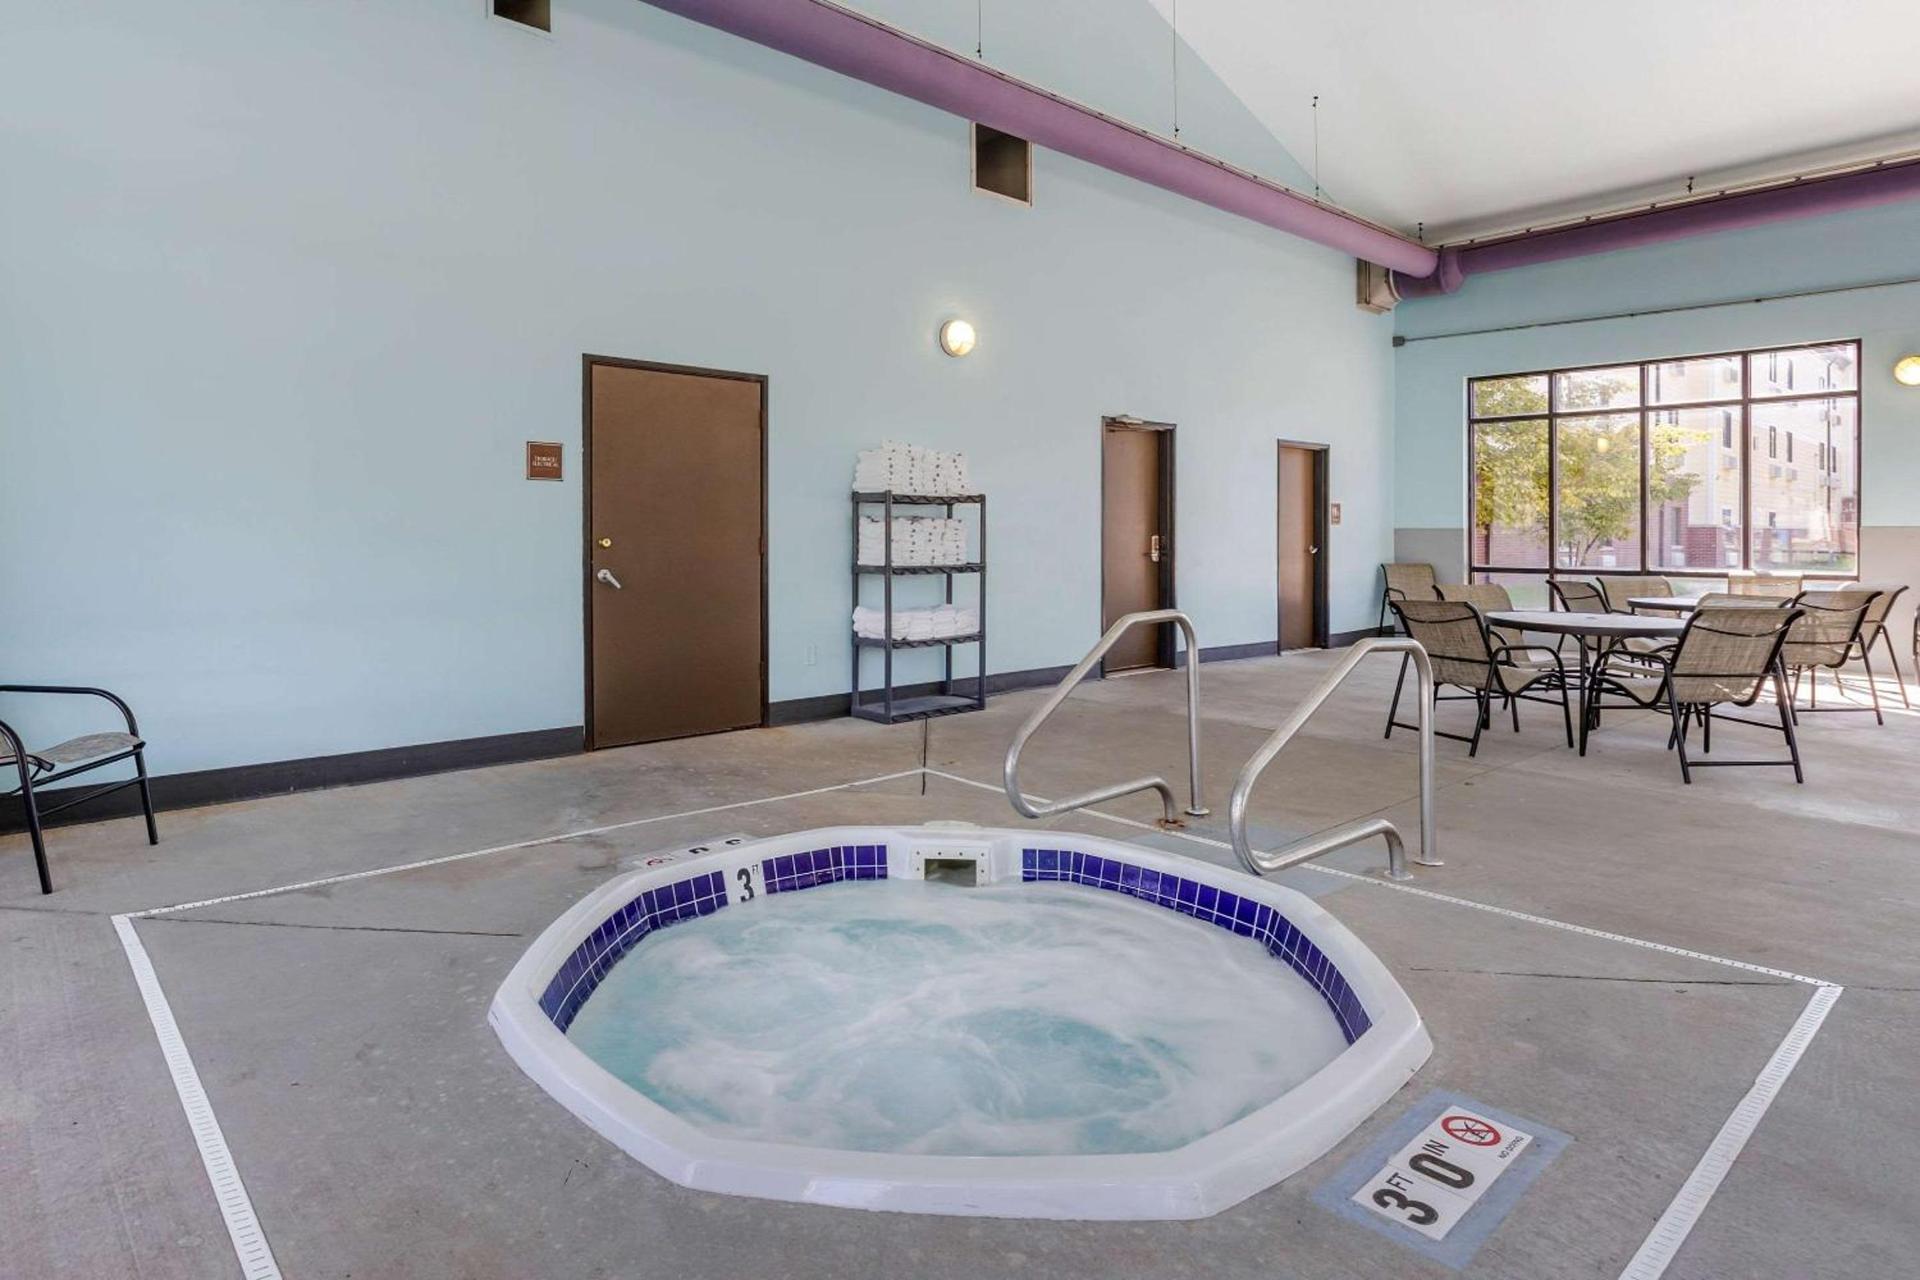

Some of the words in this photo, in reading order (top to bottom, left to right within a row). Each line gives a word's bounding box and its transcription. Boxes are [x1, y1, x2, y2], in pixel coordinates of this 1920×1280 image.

[737, 868, 755, 902] 3
[752, 864, 760, 873] FT
[1422, 1139, 1450, 1157] IN
[1498, 1150, 1510, 1159] NO
[1385, 1172, 1414, 1191] FT
[1408, 1153, 1475, 1190] 0
[1372, 1188, 1439, 1226] 3
